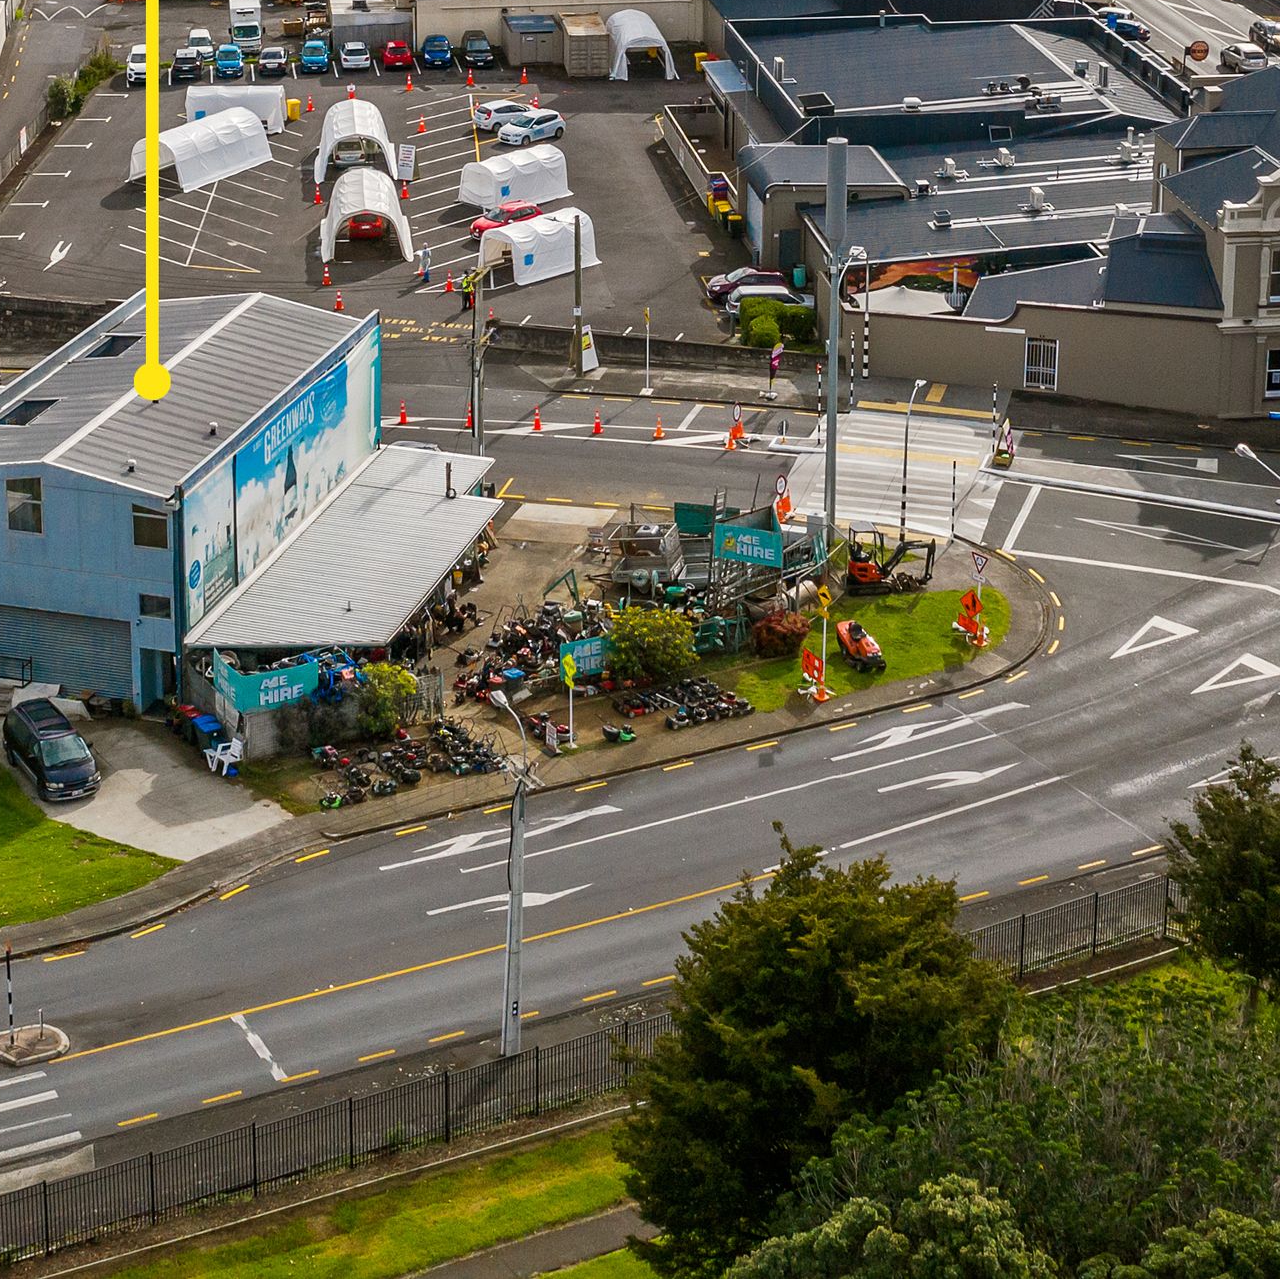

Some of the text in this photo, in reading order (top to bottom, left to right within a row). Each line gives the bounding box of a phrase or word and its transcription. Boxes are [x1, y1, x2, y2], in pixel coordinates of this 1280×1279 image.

[421, 335, 458, 343] AWAY
[264, 390, 315, 464] GREENWAYS
[736, 543, 775, 561] HIRE
[260, 683, 304, 706] HIRE
